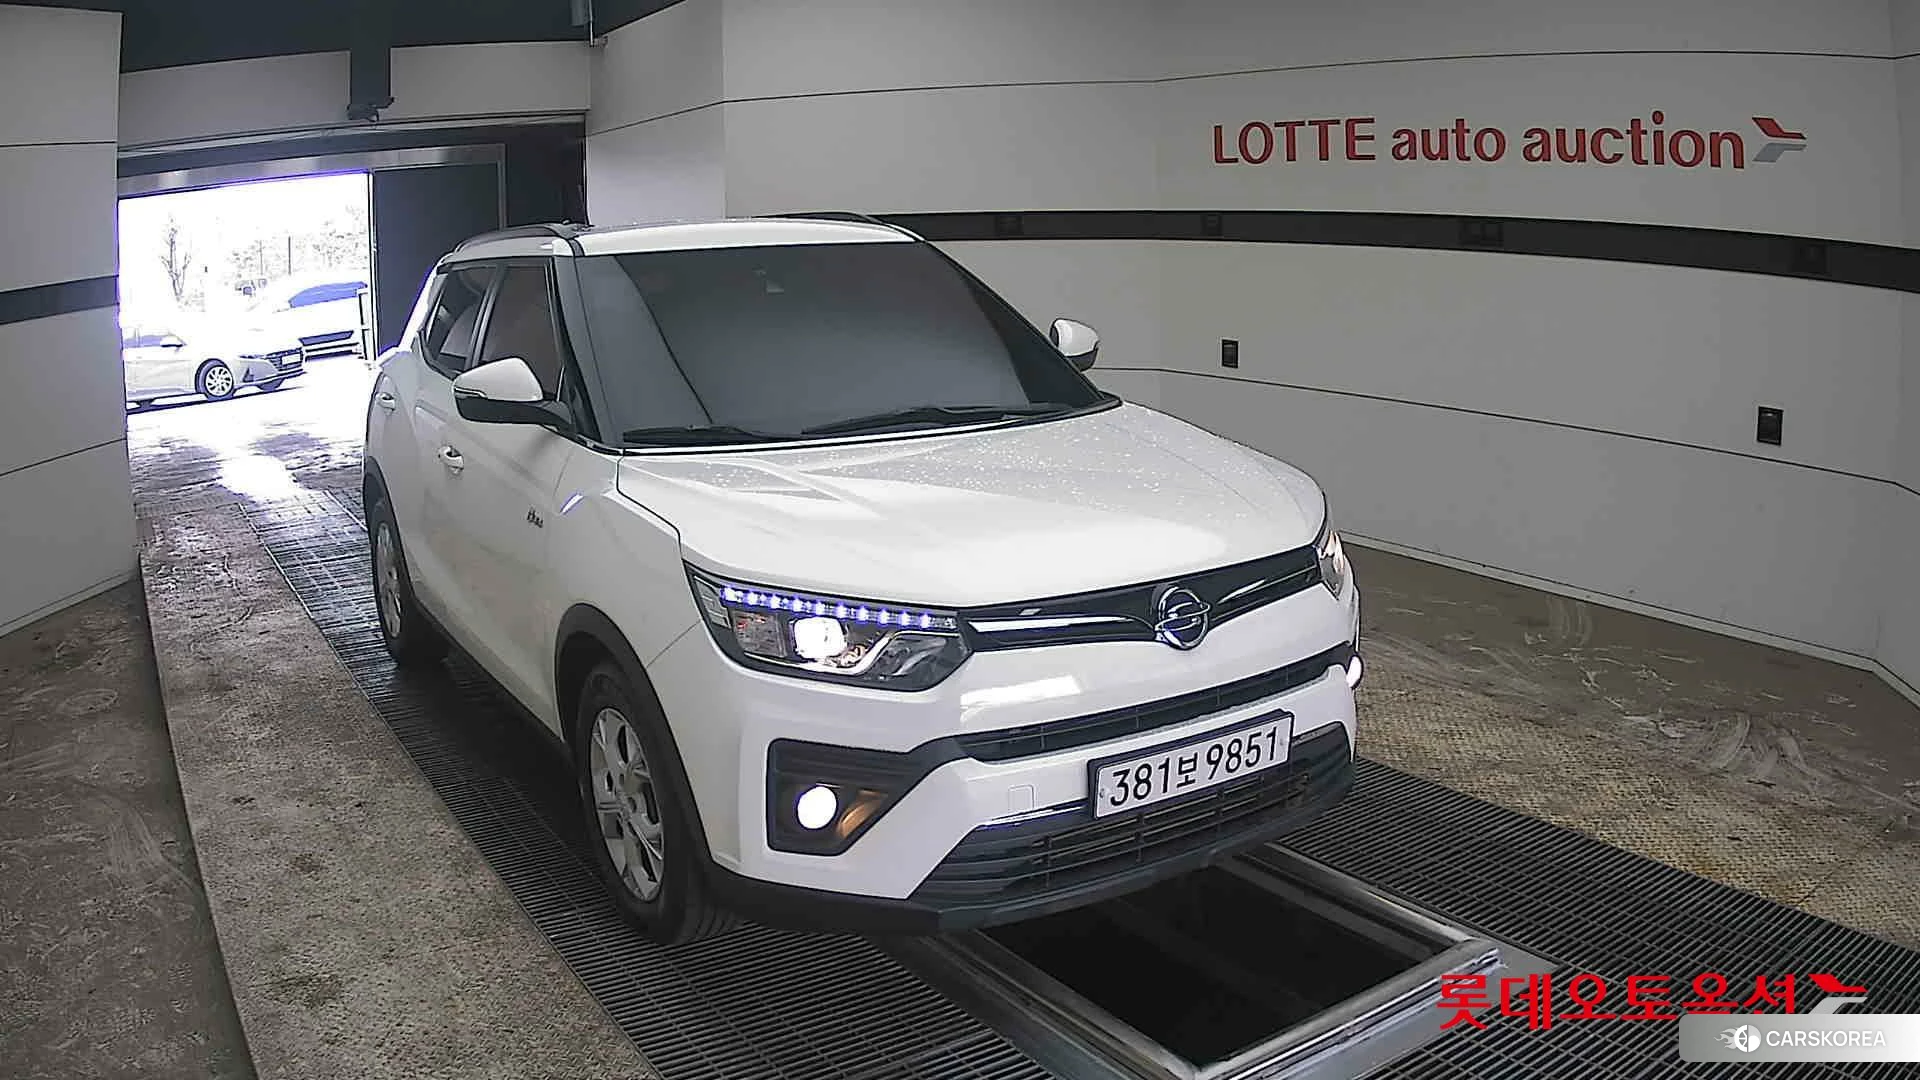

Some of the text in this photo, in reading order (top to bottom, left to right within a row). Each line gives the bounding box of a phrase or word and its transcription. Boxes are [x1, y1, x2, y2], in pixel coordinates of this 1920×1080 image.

[1212, 111, 1745, 169] LOTTE auto auction
